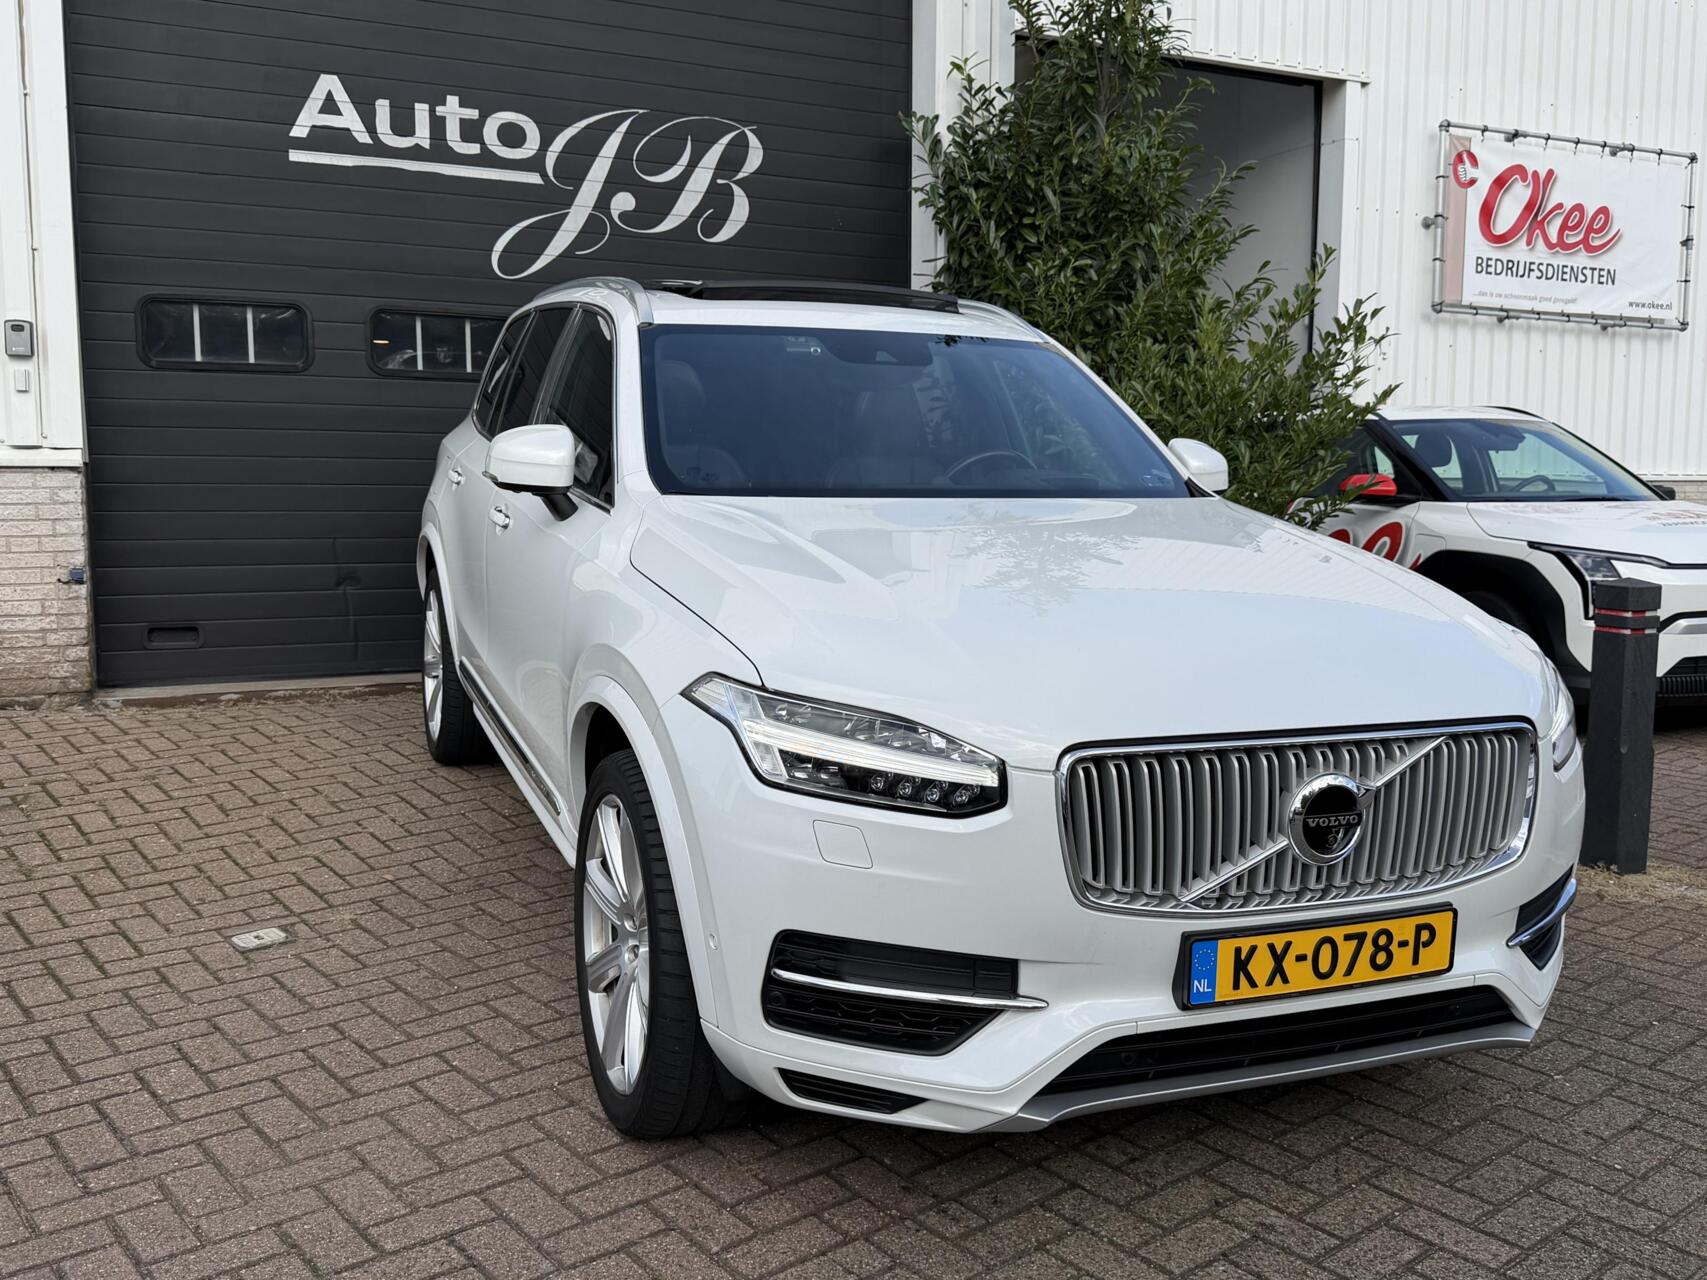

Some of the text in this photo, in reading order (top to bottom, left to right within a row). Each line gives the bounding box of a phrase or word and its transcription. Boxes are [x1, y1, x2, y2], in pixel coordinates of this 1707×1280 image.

[288, 73, 764, 279] Auto JB
[1478, 163, 1623, 257] Okee
[1475, 256, 1617, 286] BEDRIJFSDIENSTEN
[1628, 300, 1673, 311] www.okee.nl
[1305, 815, 1359, 828] VOLVO
[1193, 922, 1437, 993] NL KX-078-P
